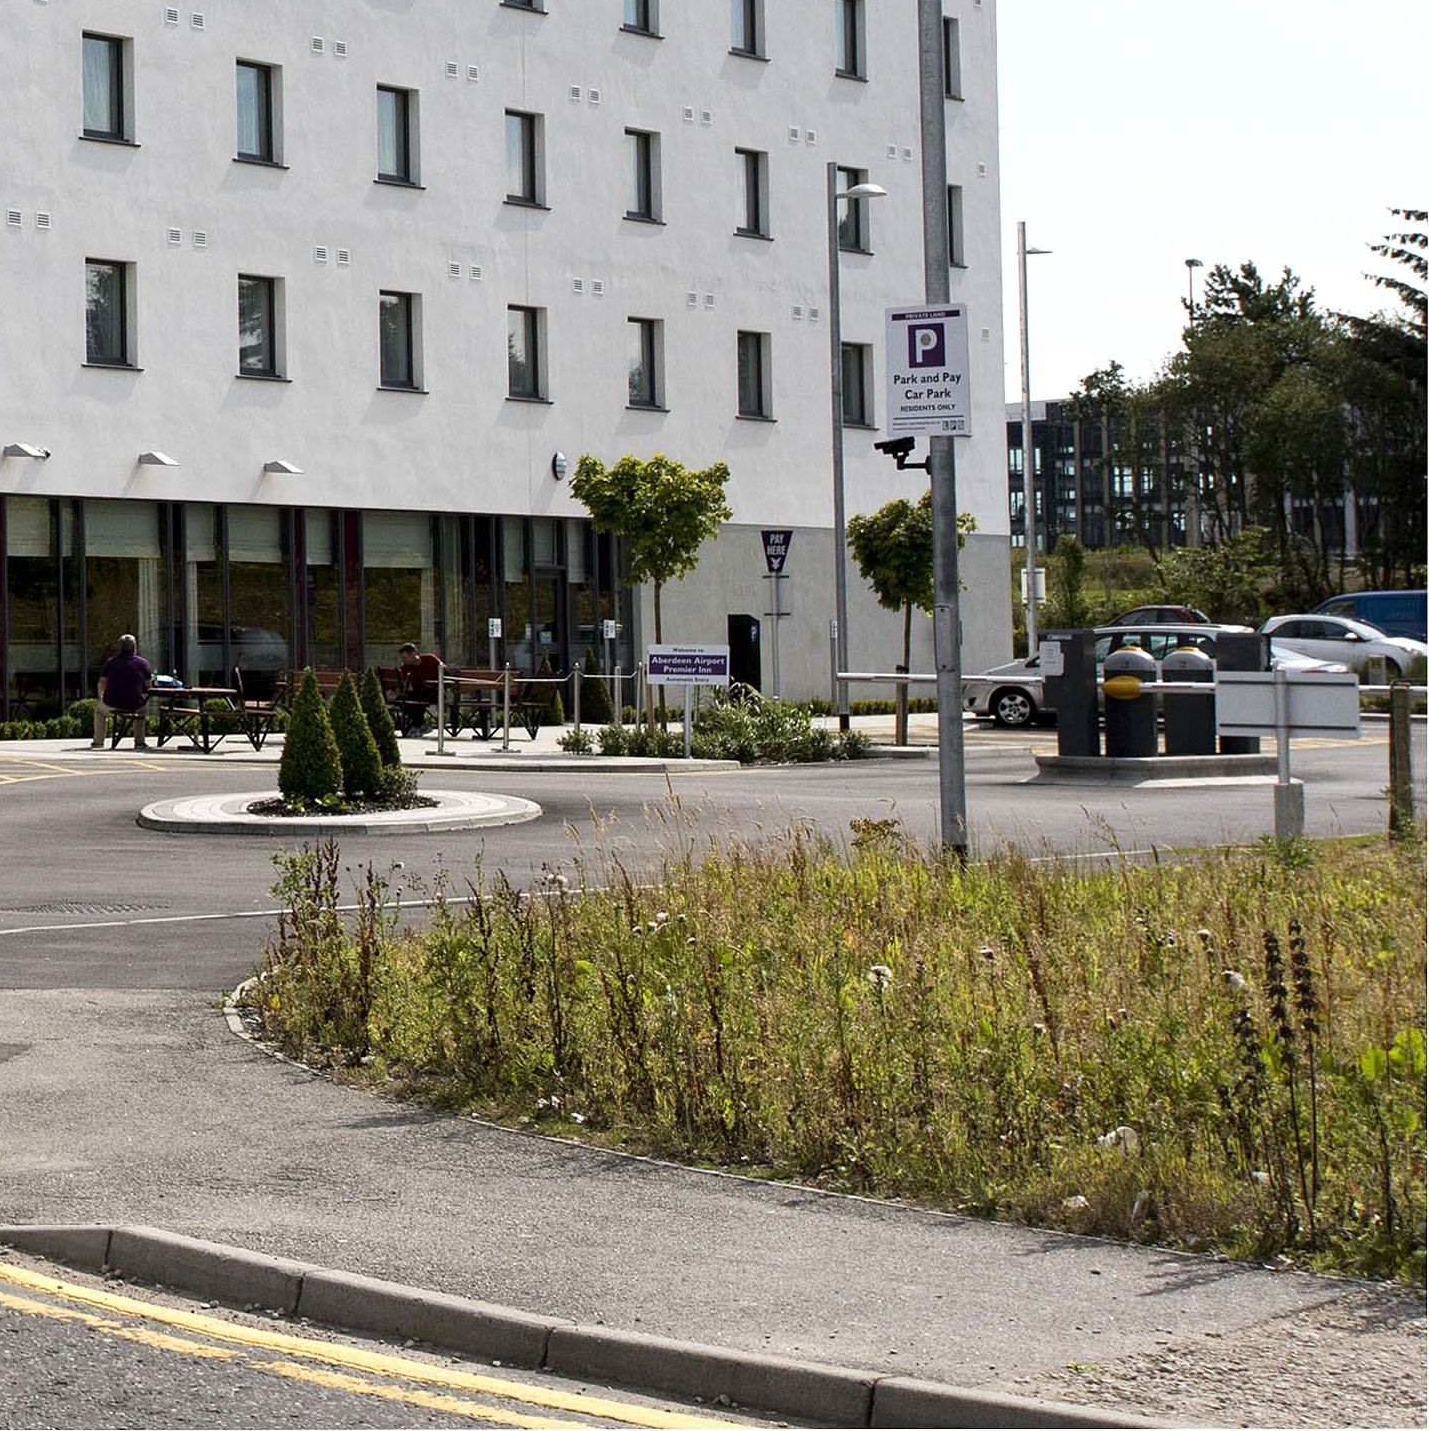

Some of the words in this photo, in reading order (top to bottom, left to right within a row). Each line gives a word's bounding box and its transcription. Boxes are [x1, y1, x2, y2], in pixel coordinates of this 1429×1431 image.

[915, 329, 937, 363] P
[893, 374, 917, 385] Park
[921, 373, 939, 383] and
[943, 372, 961, 384] Pay
[905, 389, 923, 400] Car
[927, 388, 951, 399] Park
[900, 404, 936, 412] RESIDENTS
[769, 534, 784, 544] PAY
[767, 545, 786, 555] HERE
[651, 656, 692, 664] Aberdeen
[694, 657, 725, 666] Airport
